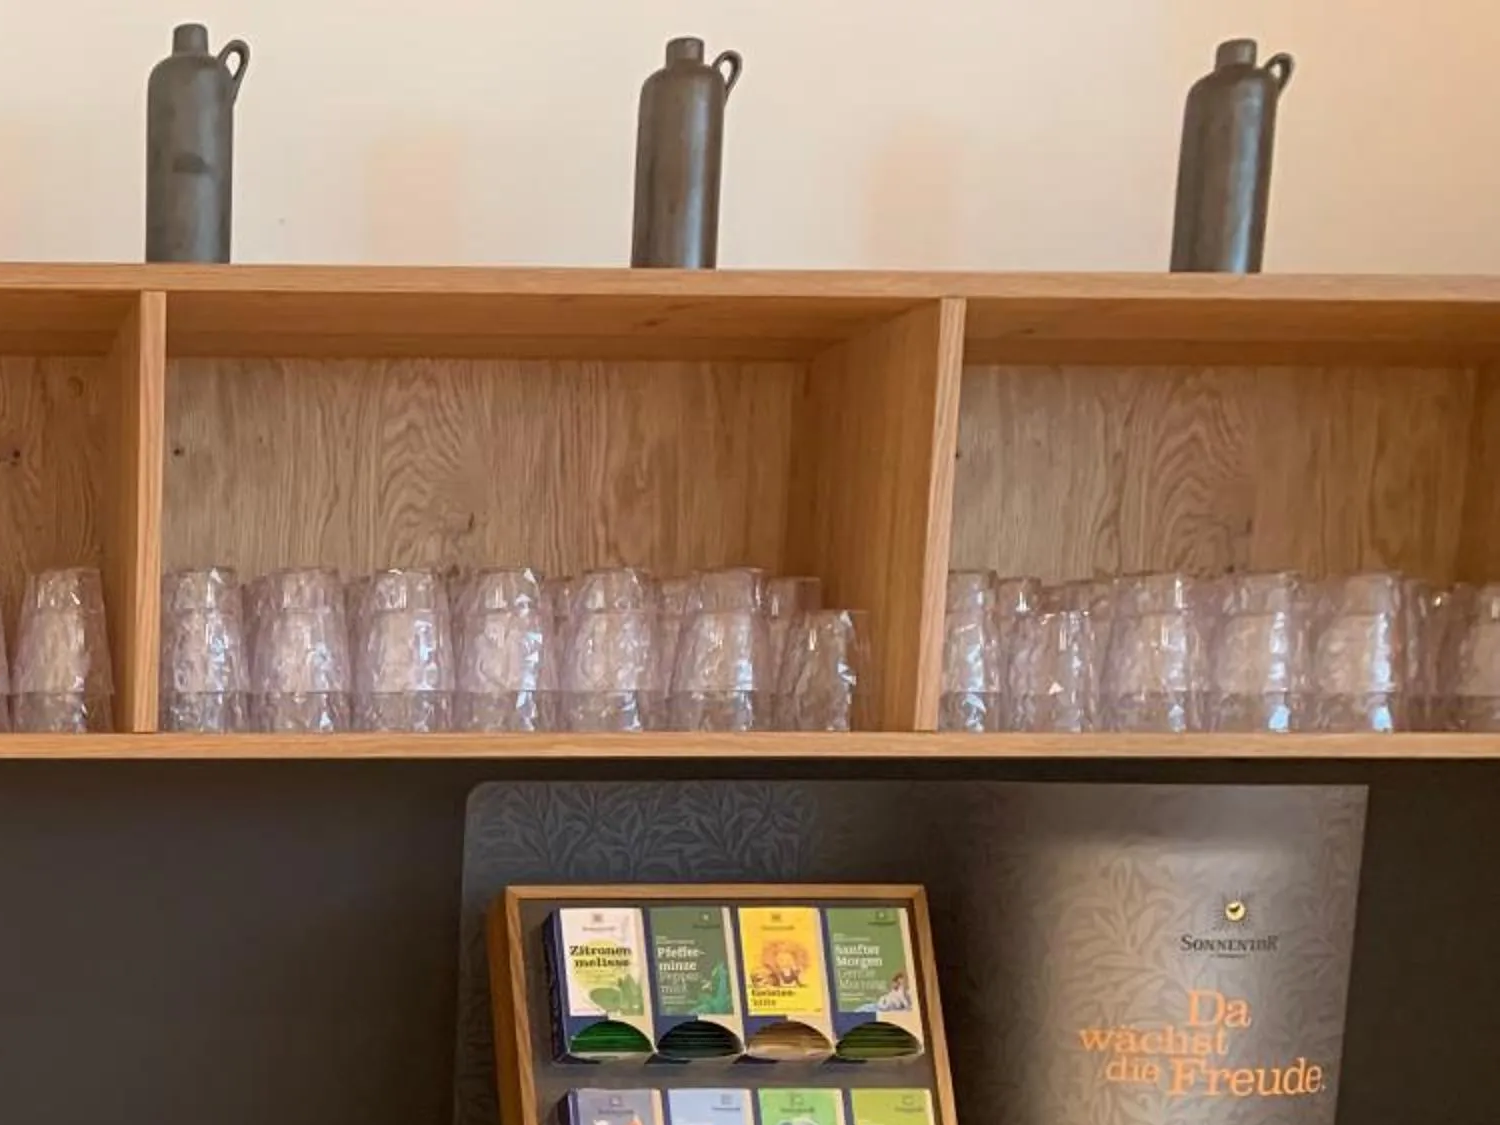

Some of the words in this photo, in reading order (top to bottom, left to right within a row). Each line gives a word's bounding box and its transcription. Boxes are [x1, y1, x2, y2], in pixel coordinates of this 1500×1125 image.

[569, 945, 632, 957] Zitronen
[1187, 988, 1251, 1028] Da
[1079, 1024, 1228, 1055] wächst
[1105, 1054, 1160, 1082] die
[1169, 1057, 1327, 1096] Freude.
